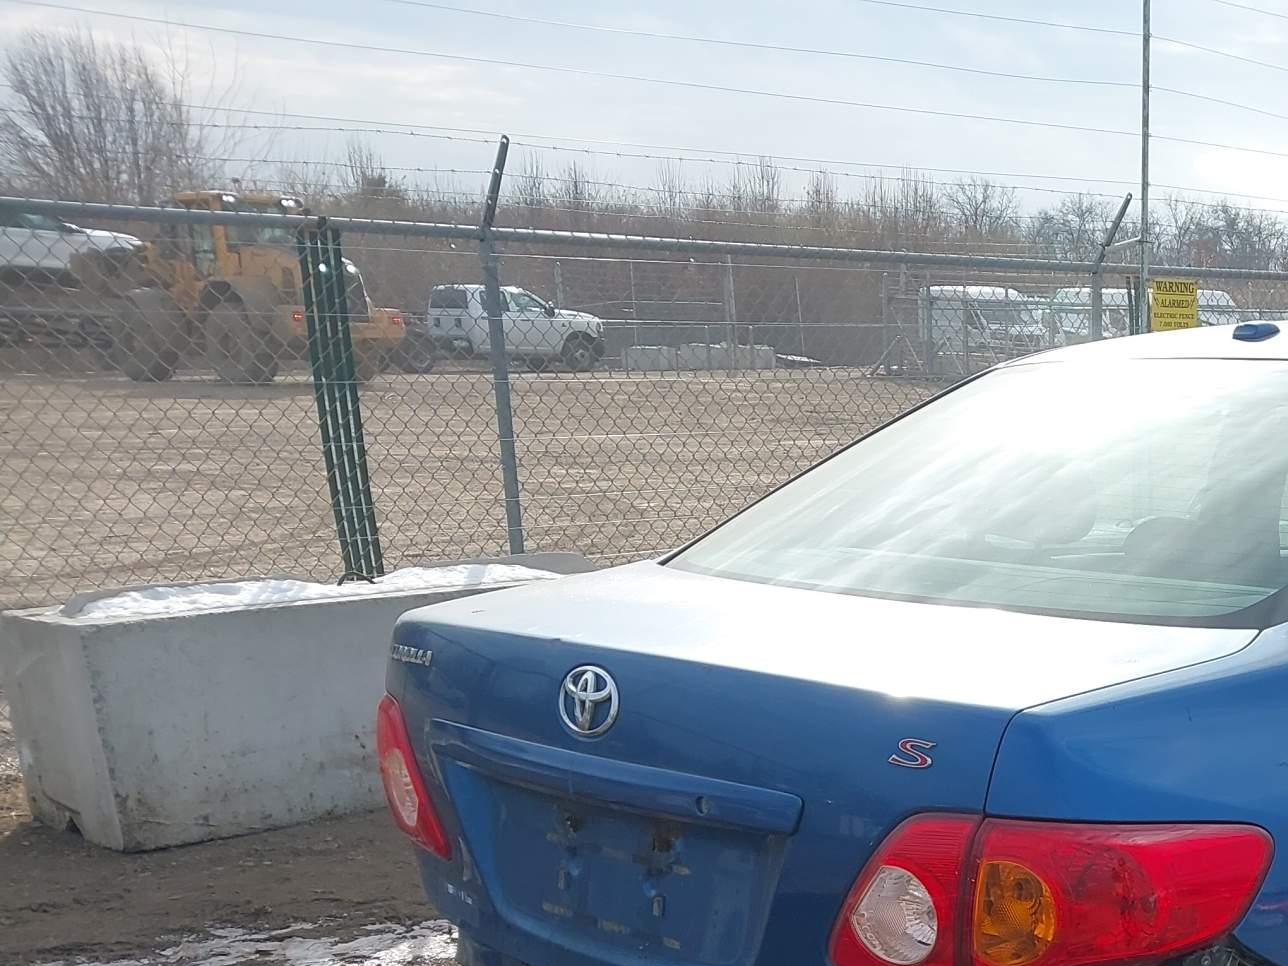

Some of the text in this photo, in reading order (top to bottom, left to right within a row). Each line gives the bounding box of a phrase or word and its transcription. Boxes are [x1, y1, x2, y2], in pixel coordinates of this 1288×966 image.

[1155, 280, 1195, 294] WARNING
[1160, 298, 1189, 308] ALARMED
[887, 738, 937, 768] S
